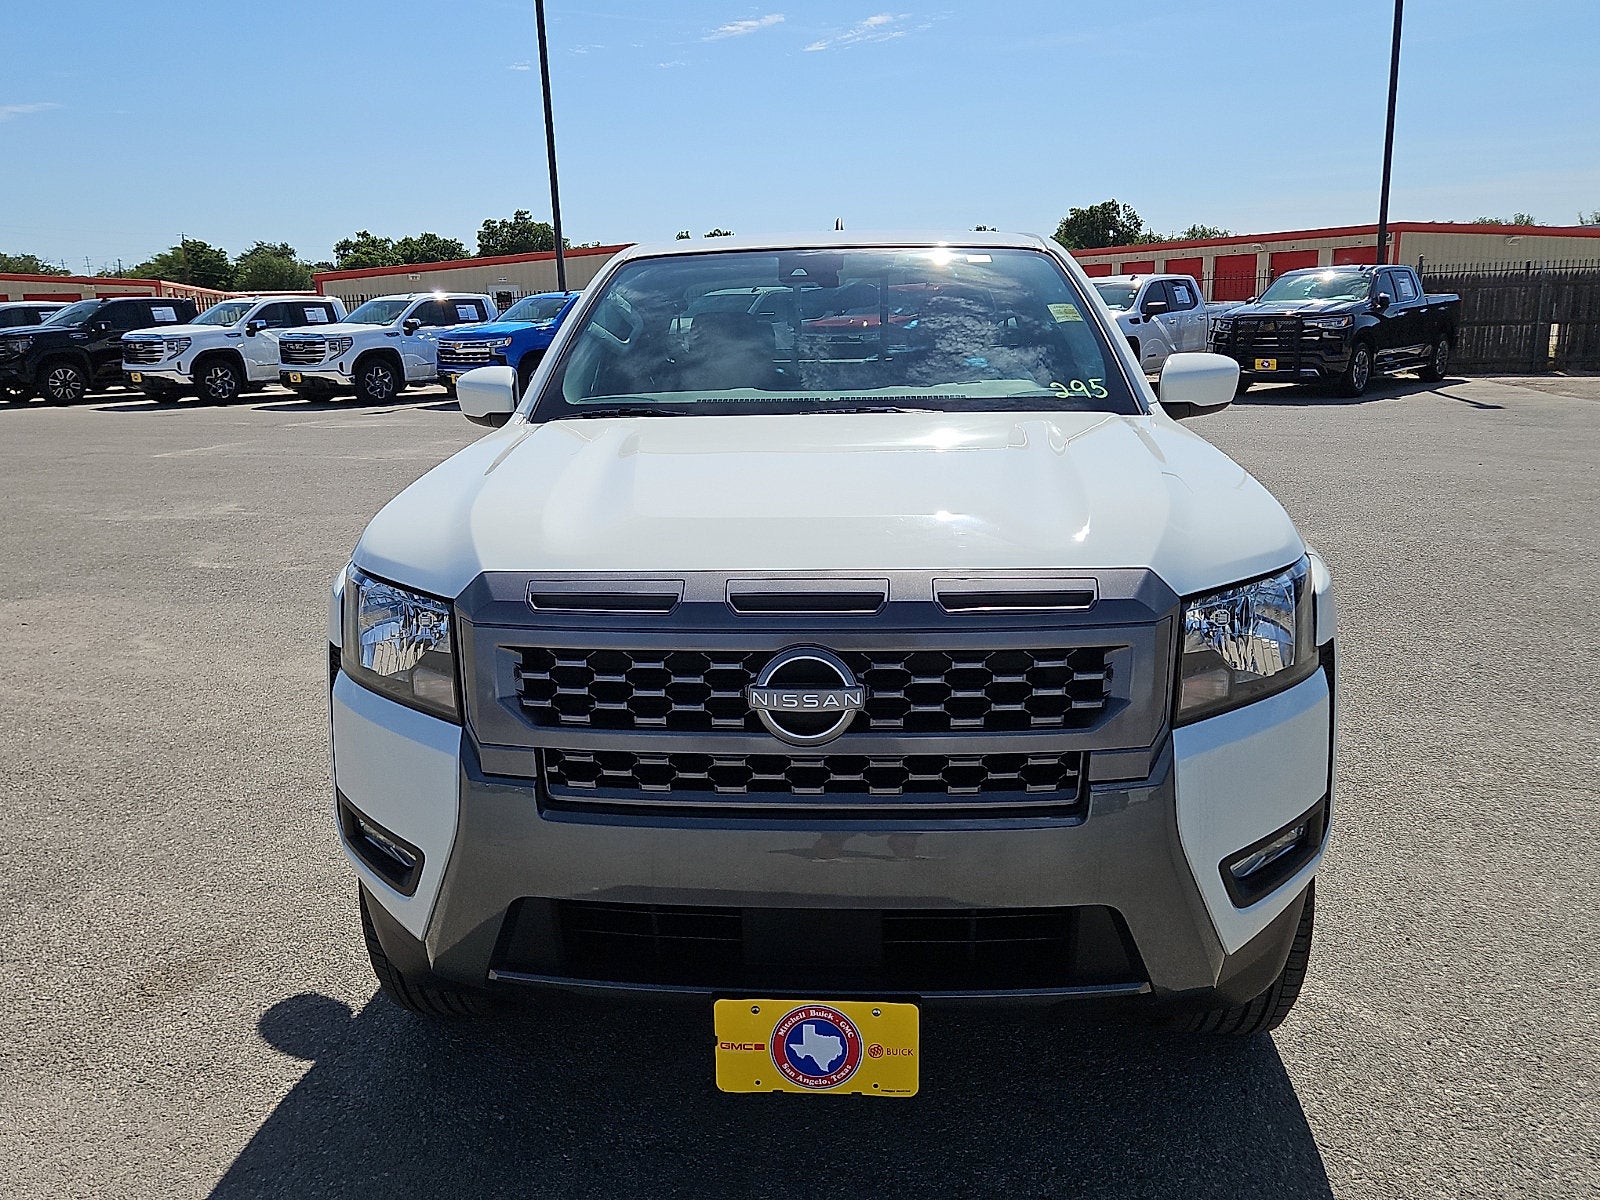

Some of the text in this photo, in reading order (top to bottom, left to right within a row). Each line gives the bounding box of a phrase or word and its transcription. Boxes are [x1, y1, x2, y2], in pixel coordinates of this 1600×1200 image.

[1049, 378, 1109, 399] 295
[752, 692, 861, 708] NISSAN
[777, 1010, 806, 1037] Mitchell
[809, 1009, 834, 1021] Buick
[839, 1020, 855, 1039] GMC
[719, 1042, 754, 1051] GMC
[886, 1047, 914, 1056] BUICK
[781, 1062, 853, 1086] San Angelo, Texas
